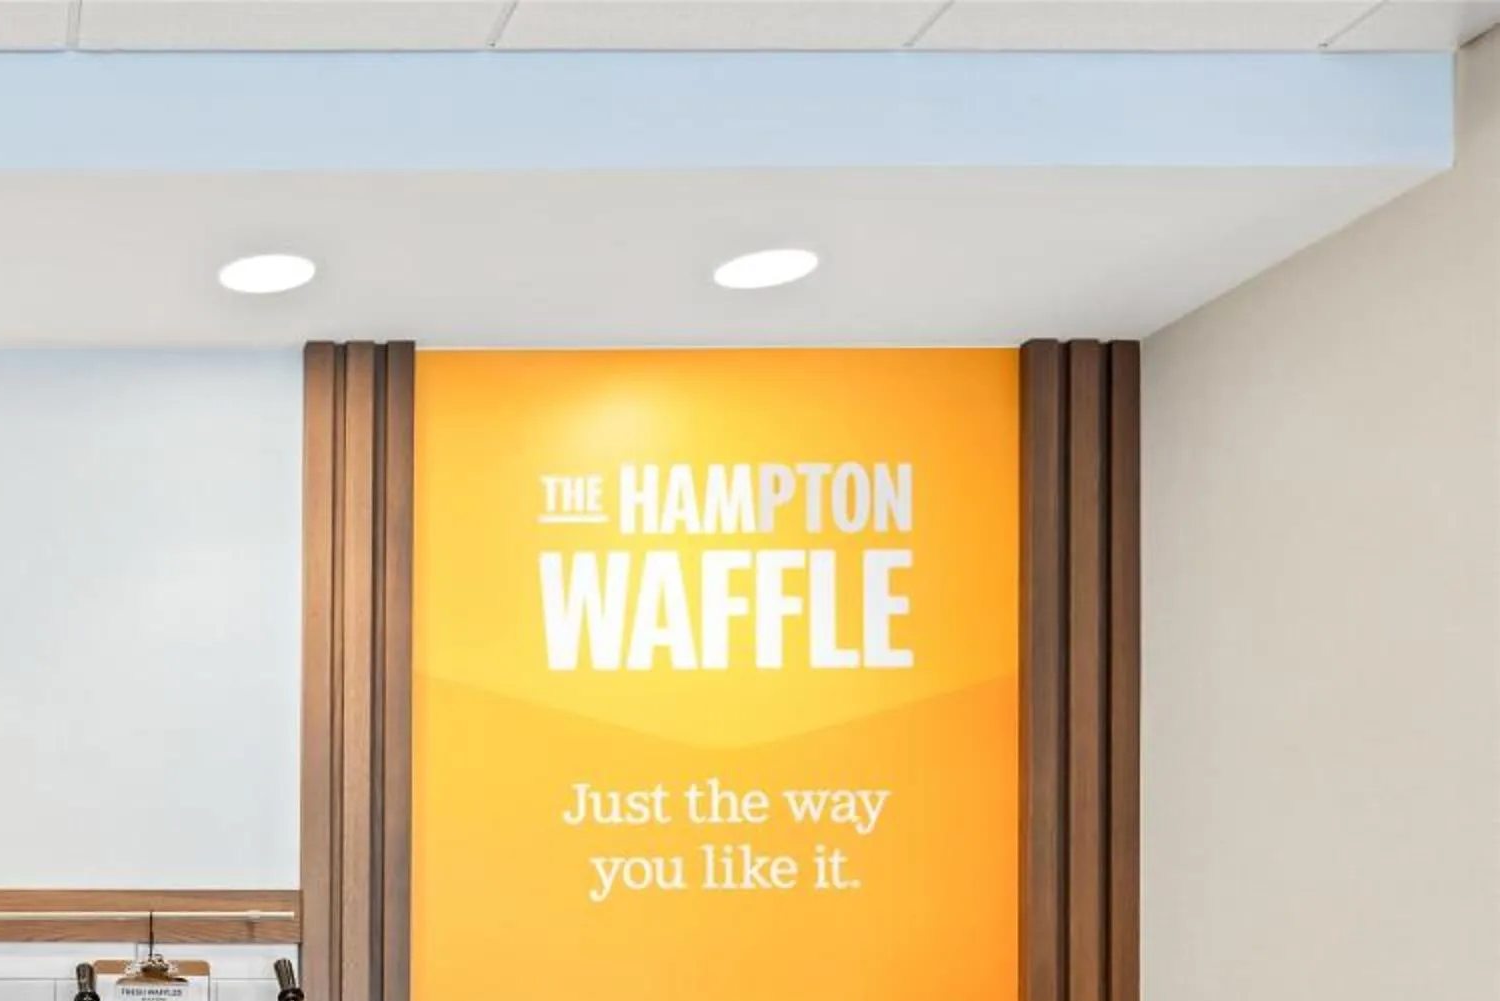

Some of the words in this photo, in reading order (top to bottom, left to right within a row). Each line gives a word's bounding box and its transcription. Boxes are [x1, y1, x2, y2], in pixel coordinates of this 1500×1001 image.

[540, 475, 604, 513] THE
[619, 461, 914, 535] HAMPTON
[538, 548, 914, 671] WAFFLE
[563, 782, 672, 825] Just
[684, 778, 770, 824] the
[783, 788, 892, 834] way
[588, 852, 686, 902] you
[702, 844, 798, 890] like
[814, 844, 861, 890] it.
